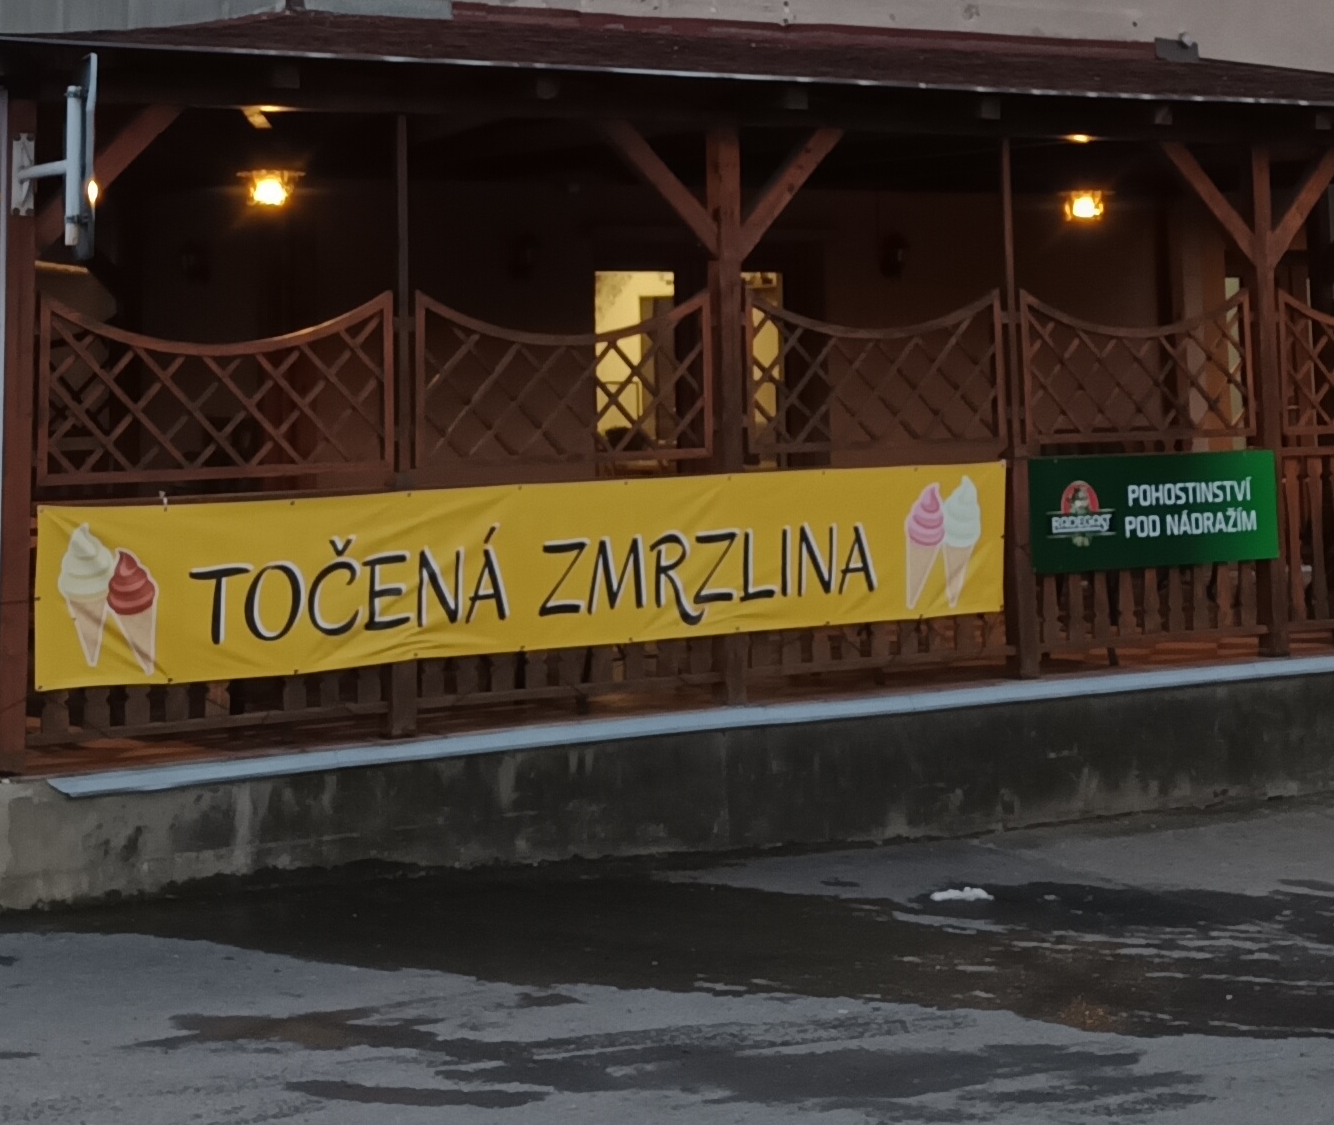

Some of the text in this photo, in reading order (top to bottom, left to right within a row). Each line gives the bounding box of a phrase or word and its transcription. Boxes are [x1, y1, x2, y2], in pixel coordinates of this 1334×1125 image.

[1127, 476, 1252, 507] POHOSTINSTVÍ
[1052, 514, 1112, 533] RADEGAST
[1125, 508, 1257, 538] POD NÁDRAŽÍM
[189, 522, 878, 645] TOČENÁ ZMRZLINA
